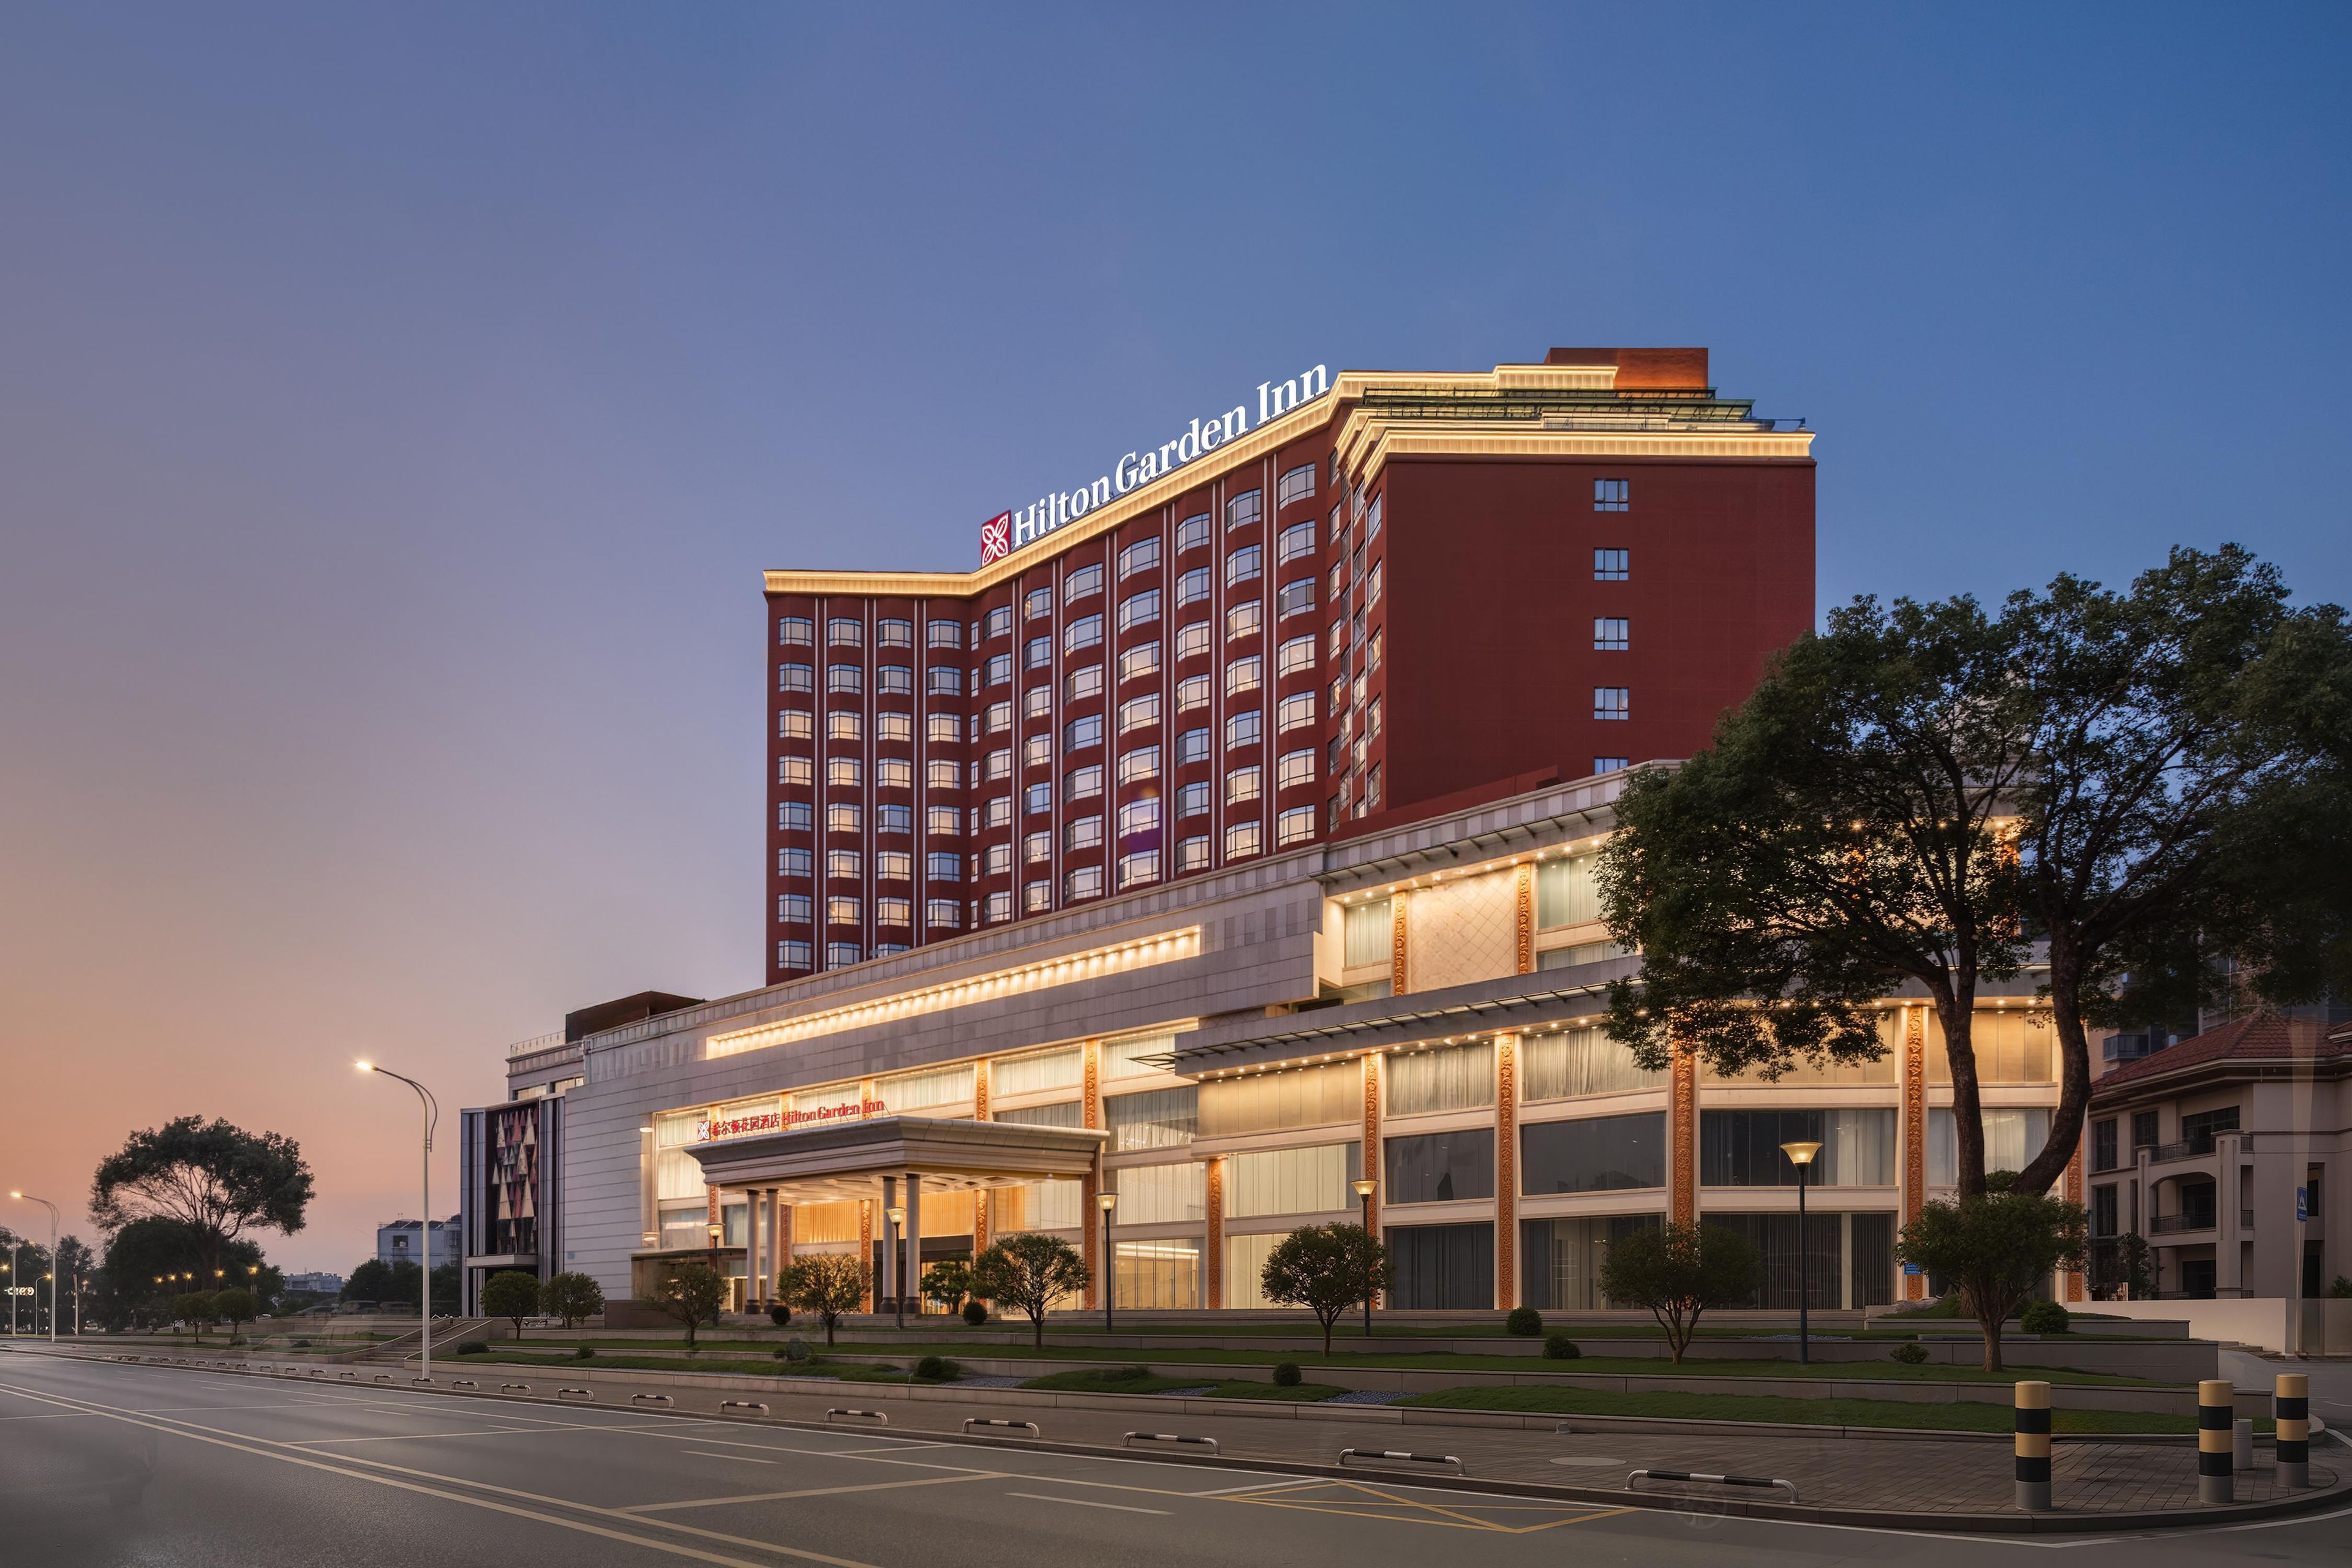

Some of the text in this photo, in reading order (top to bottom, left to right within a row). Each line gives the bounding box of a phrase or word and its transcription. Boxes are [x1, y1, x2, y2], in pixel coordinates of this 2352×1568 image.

[1015, 364, 1330, 547] Hilton Garden Inn
[712, 1099, 884, 1137] 希尔顿花园酒店 Hilton Garden Inn
